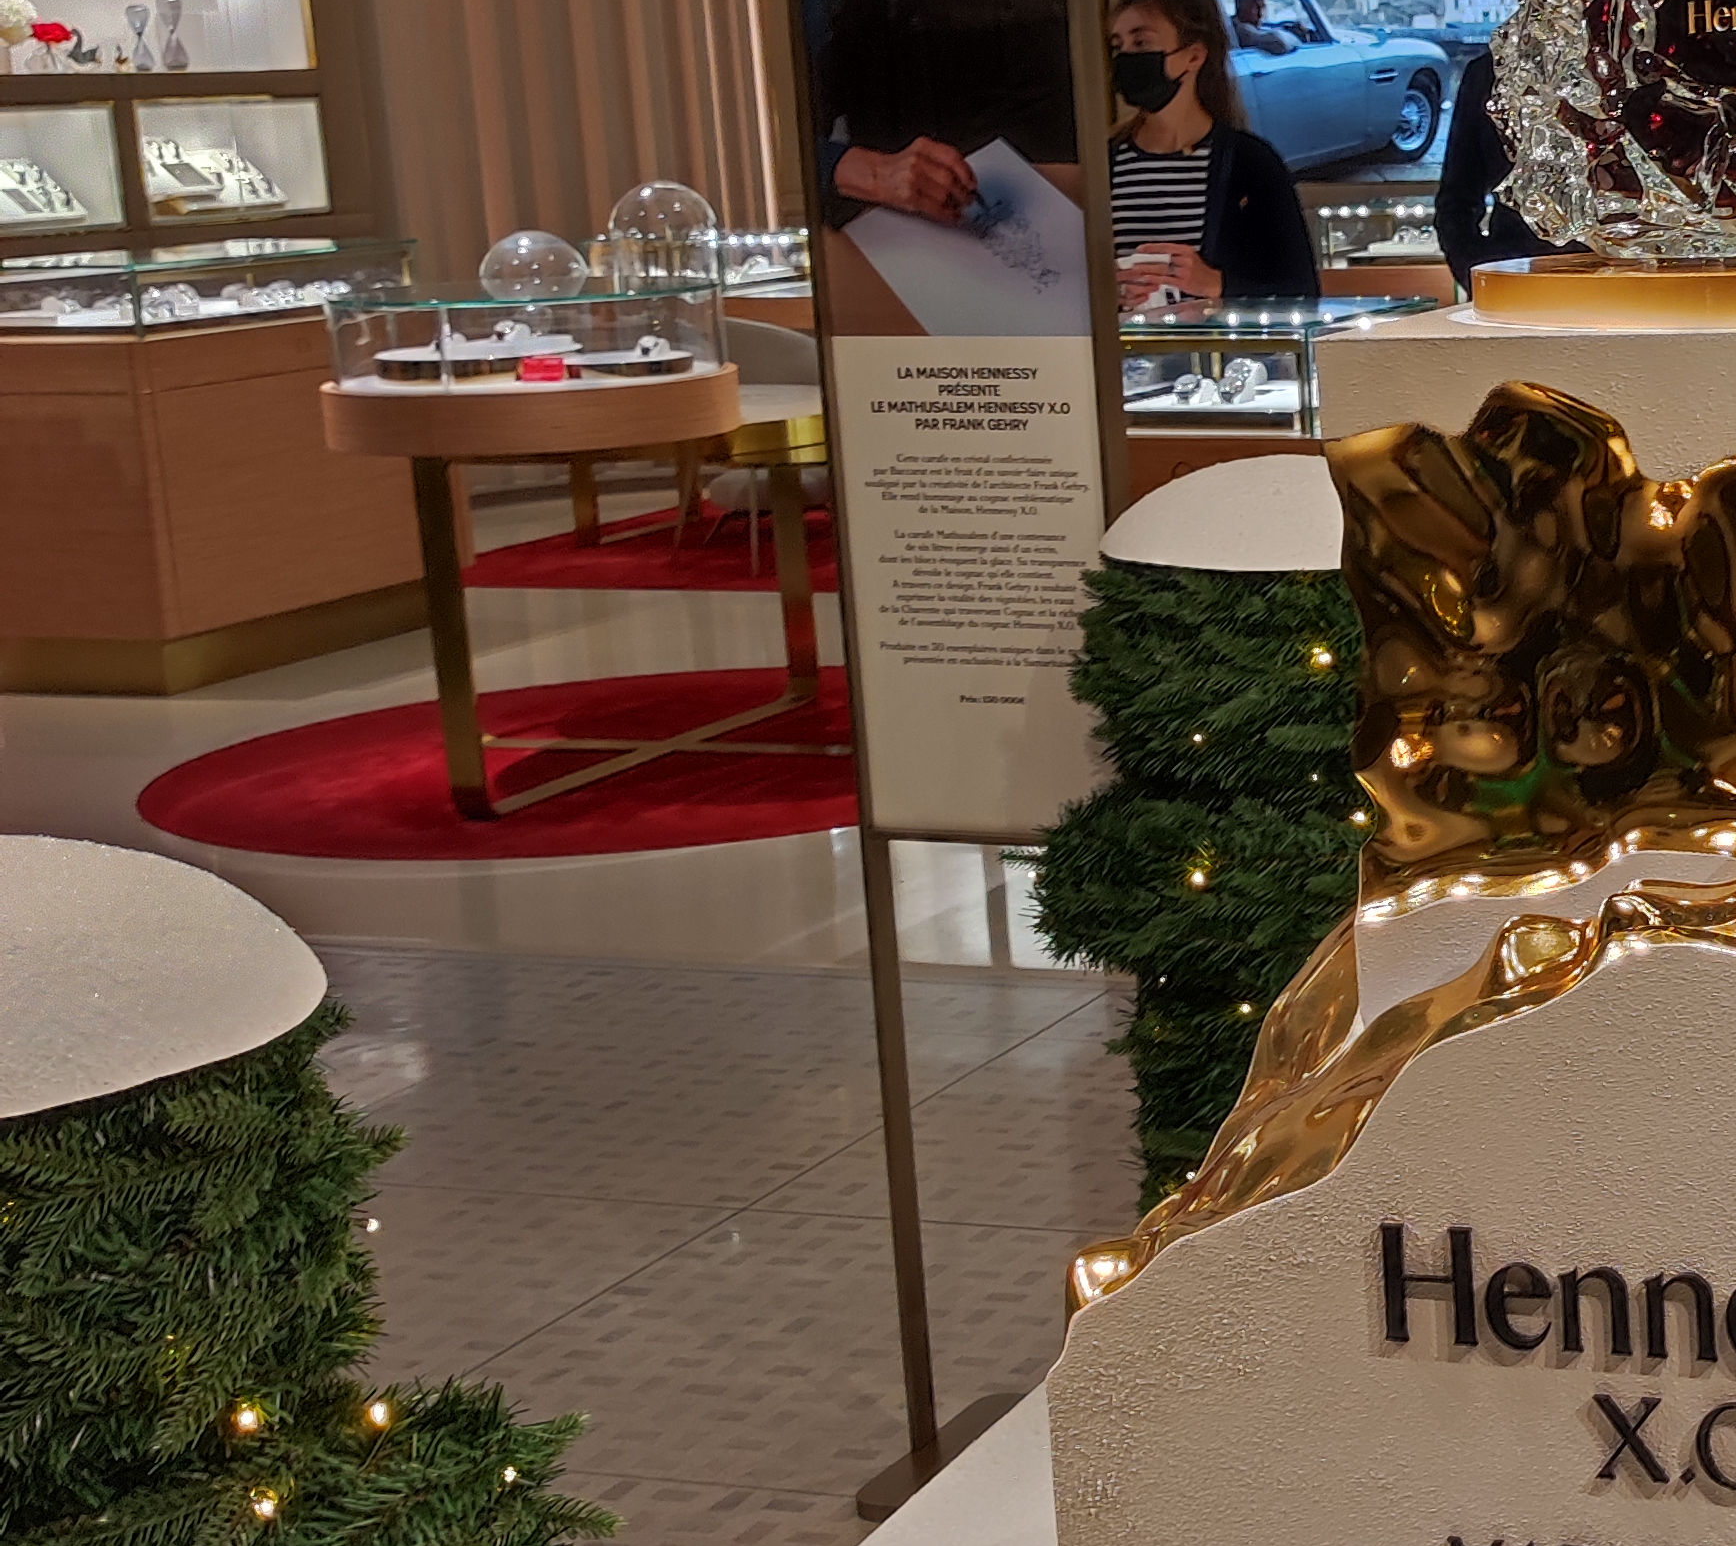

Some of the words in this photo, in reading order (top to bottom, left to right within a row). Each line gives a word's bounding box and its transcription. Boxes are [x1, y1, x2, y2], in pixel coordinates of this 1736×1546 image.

[897, 367, 914, 379] LA
[916, 367, 968, 380] MAISON
[971, 367, 1039, 380] HENNESSY
[938, 382, 1001, 397] PRÉSENTE
[871, 401, 885, 413] LE
[887, 401, 974, 414] MATHUSALEM
[977, 401, 1044, 415] HENNESSY
[915, 418, 939, 430] PAR
[942, 418, 984, 431] FRANK
[987, 418, 1029, 431] GEHRY
